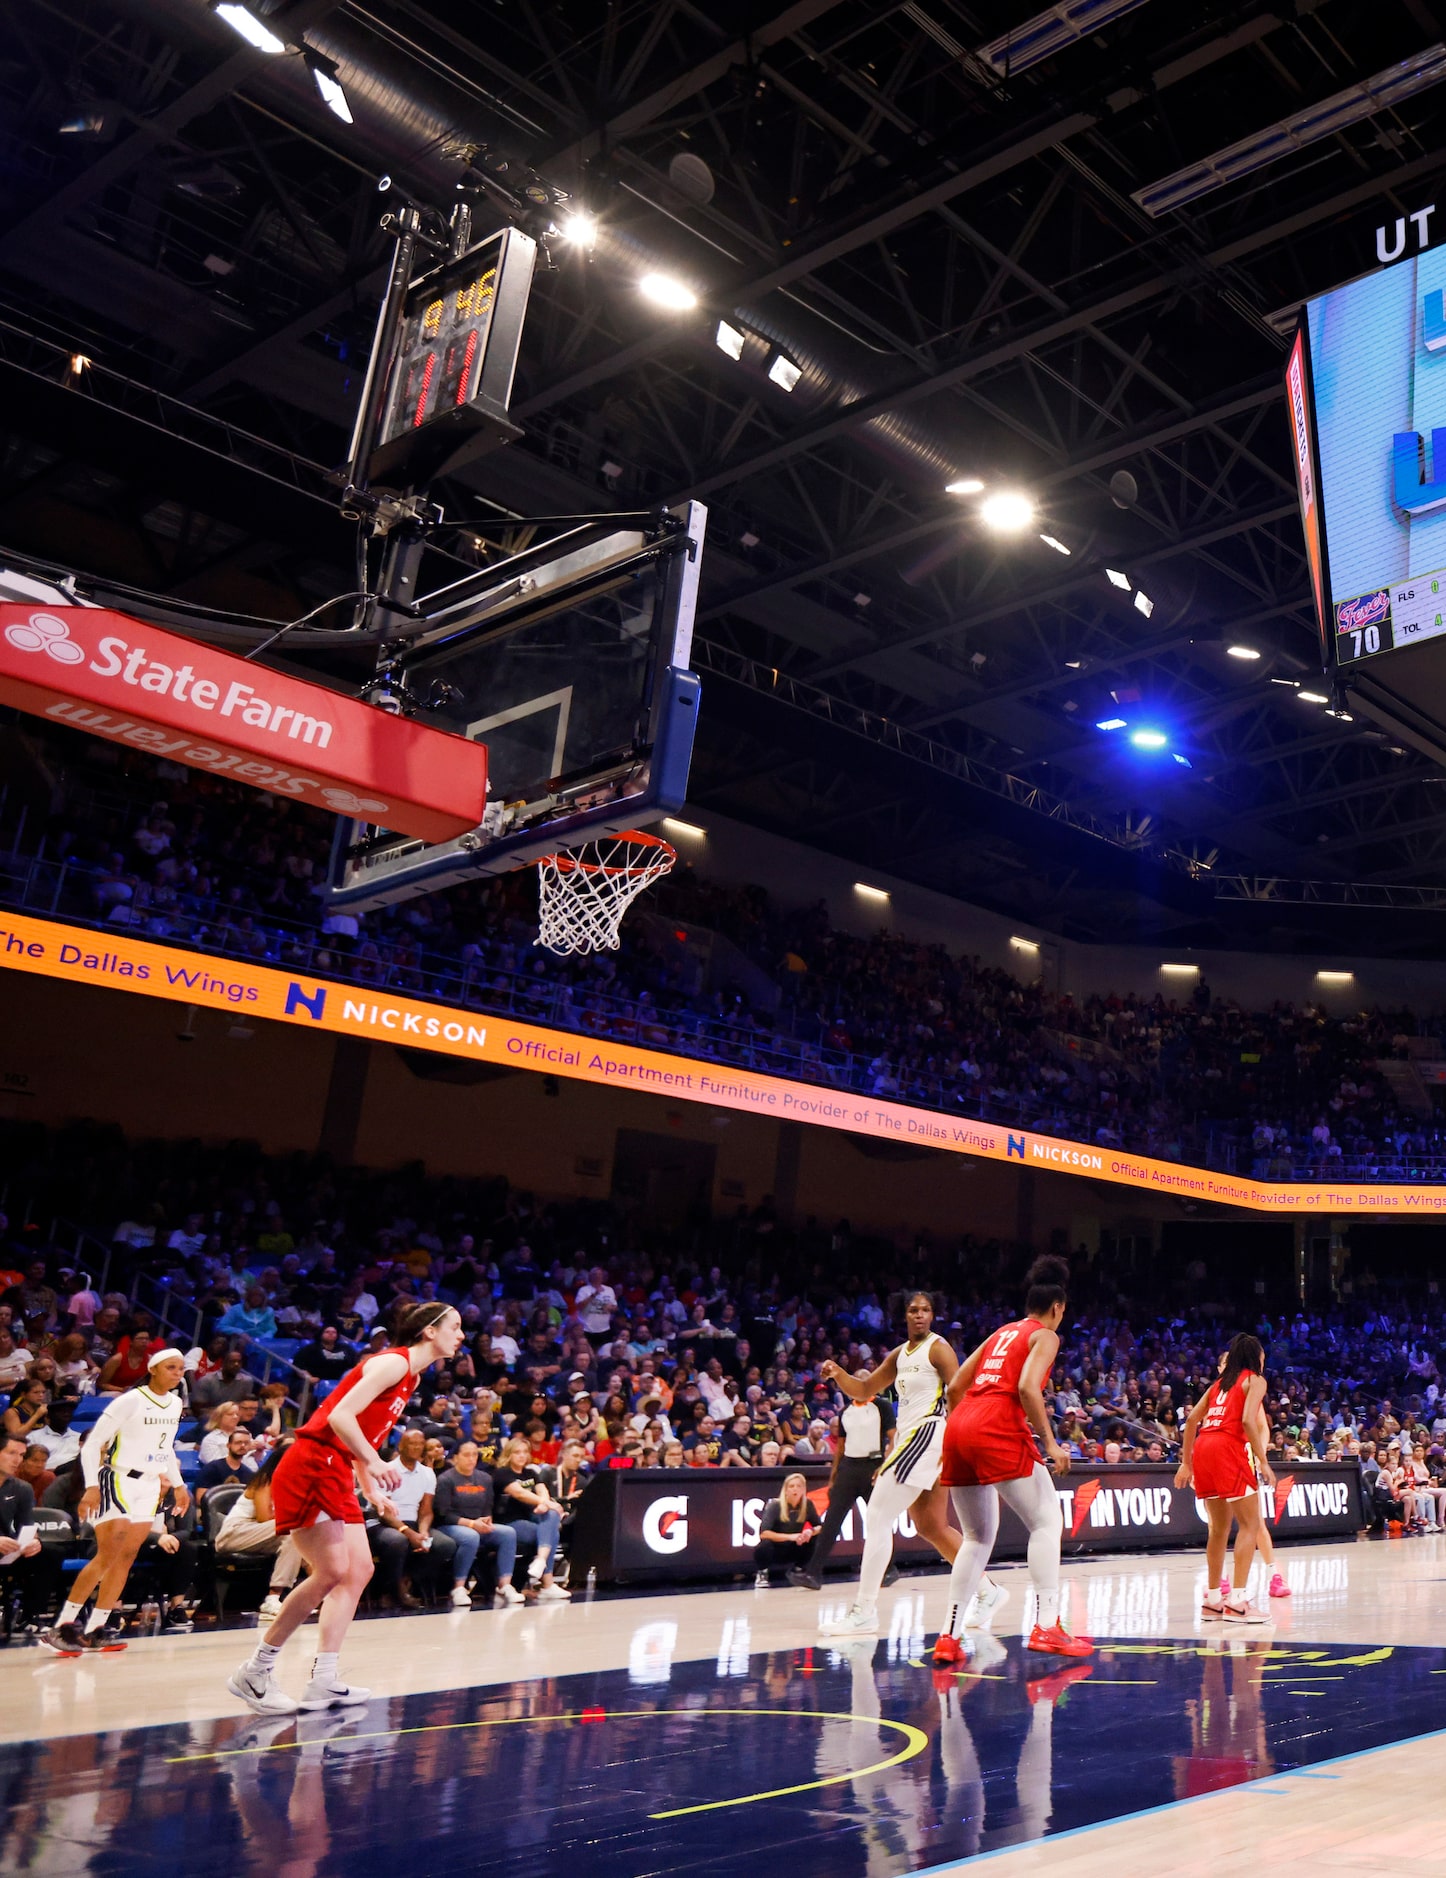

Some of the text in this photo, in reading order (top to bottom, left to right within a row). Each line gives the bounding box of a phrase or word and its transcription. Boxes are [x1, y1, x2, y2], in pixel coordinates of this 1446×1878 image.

[1376, 204, 1436, 263] UT
[1339, 591, 1390, 634] Fever
[1398, 590, 1415, 603] FLS
[1350, 625, 1381, 658] 70
[1402, 622, 1421, 635] TOL
[59, 944, 151, 979] Dallas
[165, 963, 260, 1003] Wings
[342, 1000, 487, 1047] NICKSON
[506, 1037, 580, 1066] Official
[588, 1053, 693, 1089] Apartment
[700, 1076, 777, 1105] Furniture
[783, 1092, 848, 1121] Provider
[853, 1108, 870, 1123] of
[875, 1110, 903, 1131] The
[907, 1119, 948, 1140] Dallas
[952, 1127, 996, 1151] Wings
[1032, 1143, 1103, 1170] NICKSON
[1111, 1161, 1149, 1181] Official
[1151, 1169, 1205, 1192] Apartment
[1207, 1178, 1249, 1199] Furniture
[1251, 1188, 1301, 1206] Provider
[1306, 1193, 1321, 1206] of
[1326, 1193, 1353, 1206] The
[1357, 1193, 1399, 1206] Dallas
[991, 1330, 1020, 1357] 12
[158, 1432, 167, 1449] 2
[1090, 1488, 1116, 1528] IN
[1115, 1486, 1172, 1526] YOU?
[1303, 1482, 1349, 1517] YOU?
[642, 1495, 690, 1555] G
